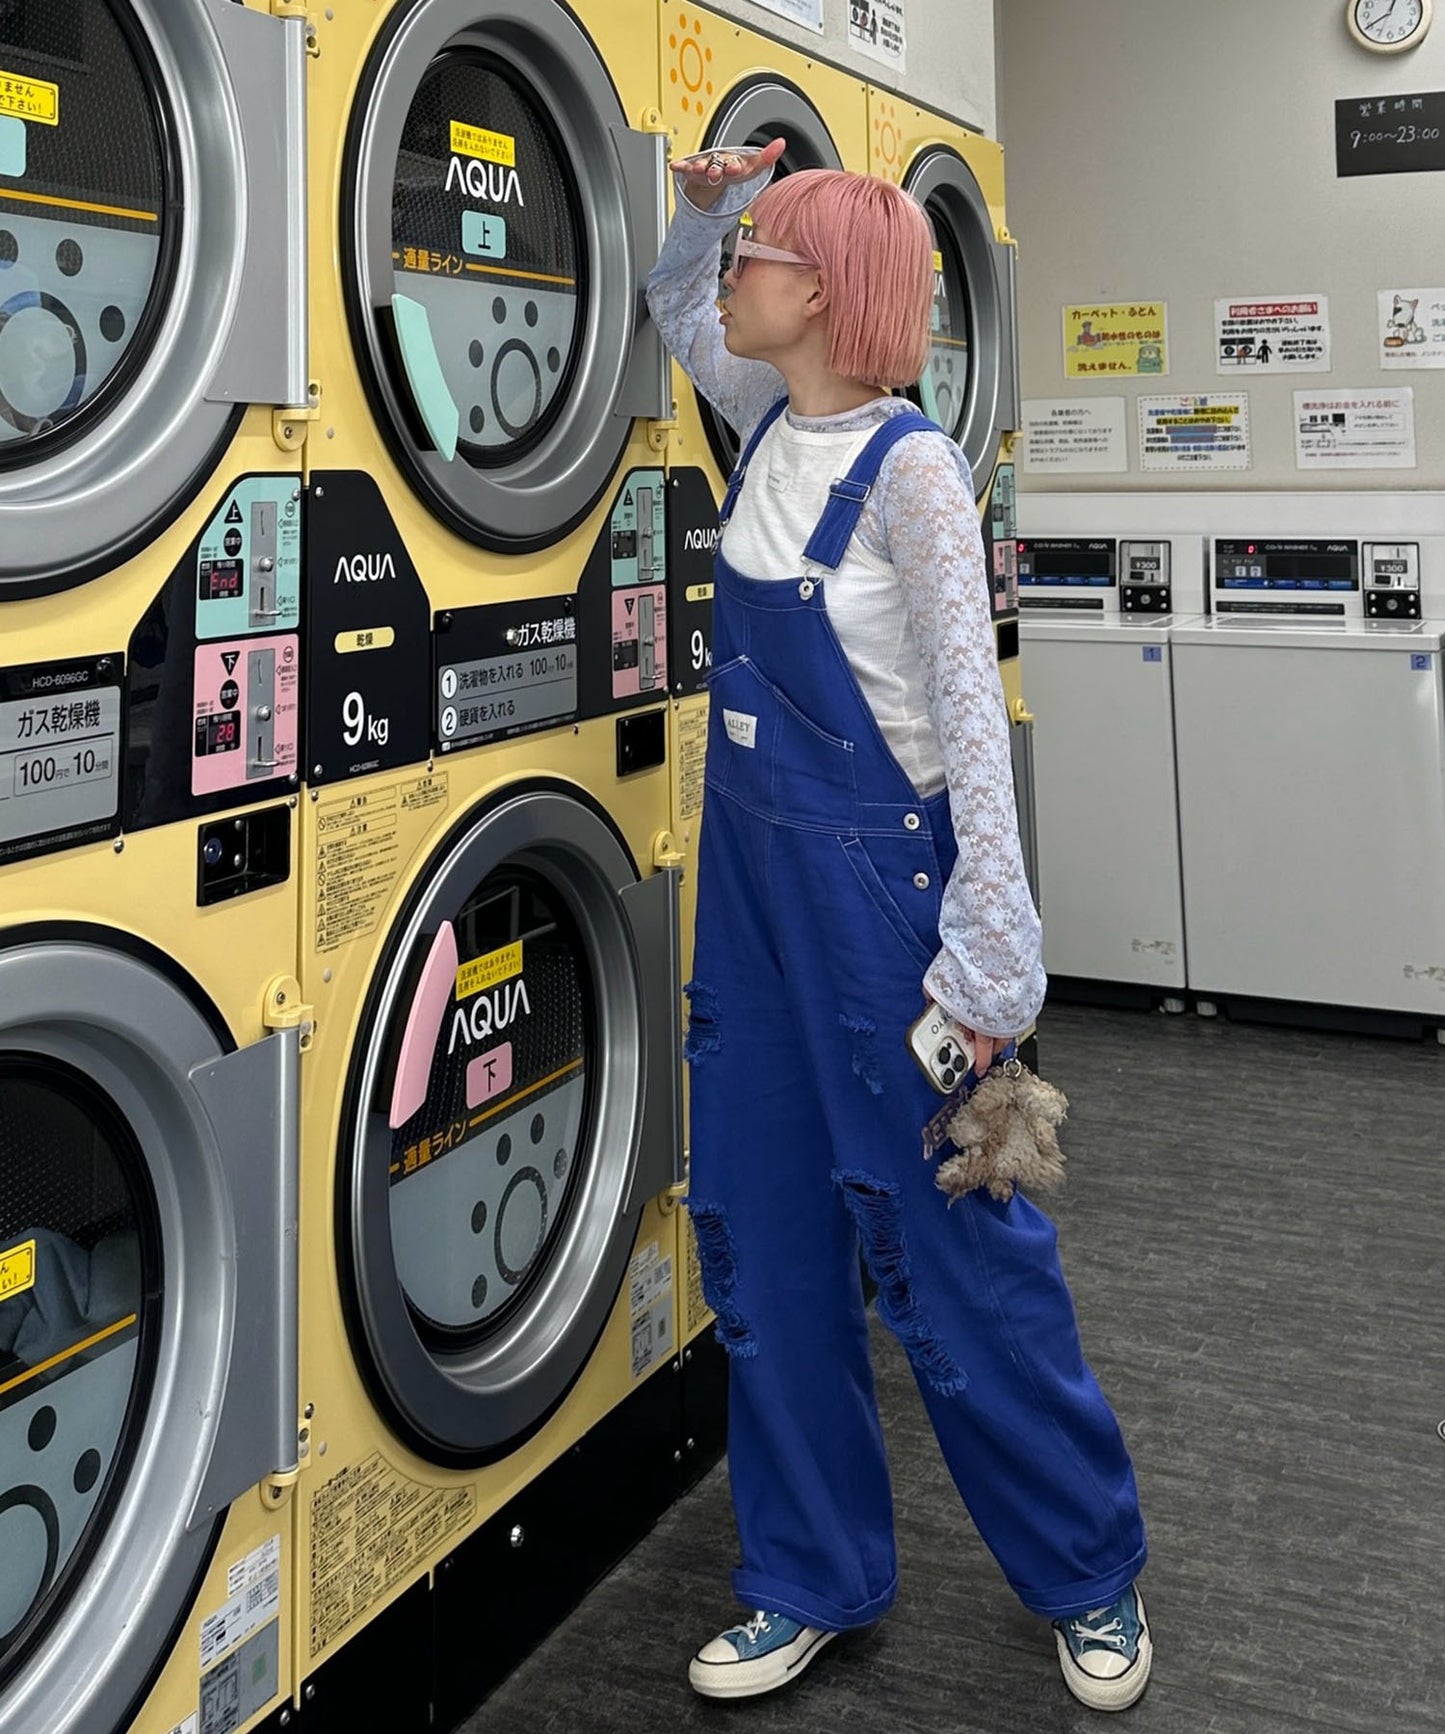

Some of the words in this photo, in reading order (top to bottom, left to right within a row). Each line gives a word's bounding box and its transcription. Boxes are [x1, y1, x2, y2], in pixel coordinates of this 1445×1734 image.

[1363, 10, 1370, 19] 9
[1410, 8, 1416, 16] 3
[1376, 28, 1382, 37] 7
[1386, 31, 1394, 40] 6
[1399, 27, 1405, 36] 5
[445, 156, 525, 207] AQUA
[478, 220, 491, 250] 上
[403, 247, 464, 274] 適量ライン
[228, 504, 240, 520] 上
[1326, 544, 1349, 552] AQUA
[334, 553, 396, 584] AQUA
[518, 616, 576, 647] ガス乾燥機
[225, 655, 236, 670] 下
[1416, 656, 1426, 667] 2
[32, 671, 89, 689] HCD-6096GC
[460, 663, 524, 690] 洗濯物を入れる
[17, 698, 101, 739] ガス乾燥機
[460, 700, 516, 727] 硬貨を入れる
[216, 722, 235, 744] 28
[447, 979, 531, 1055] AQUA
[483, 1058, 497, 1093] 下
[403, 1120, 468, 1176] 適量ライン
